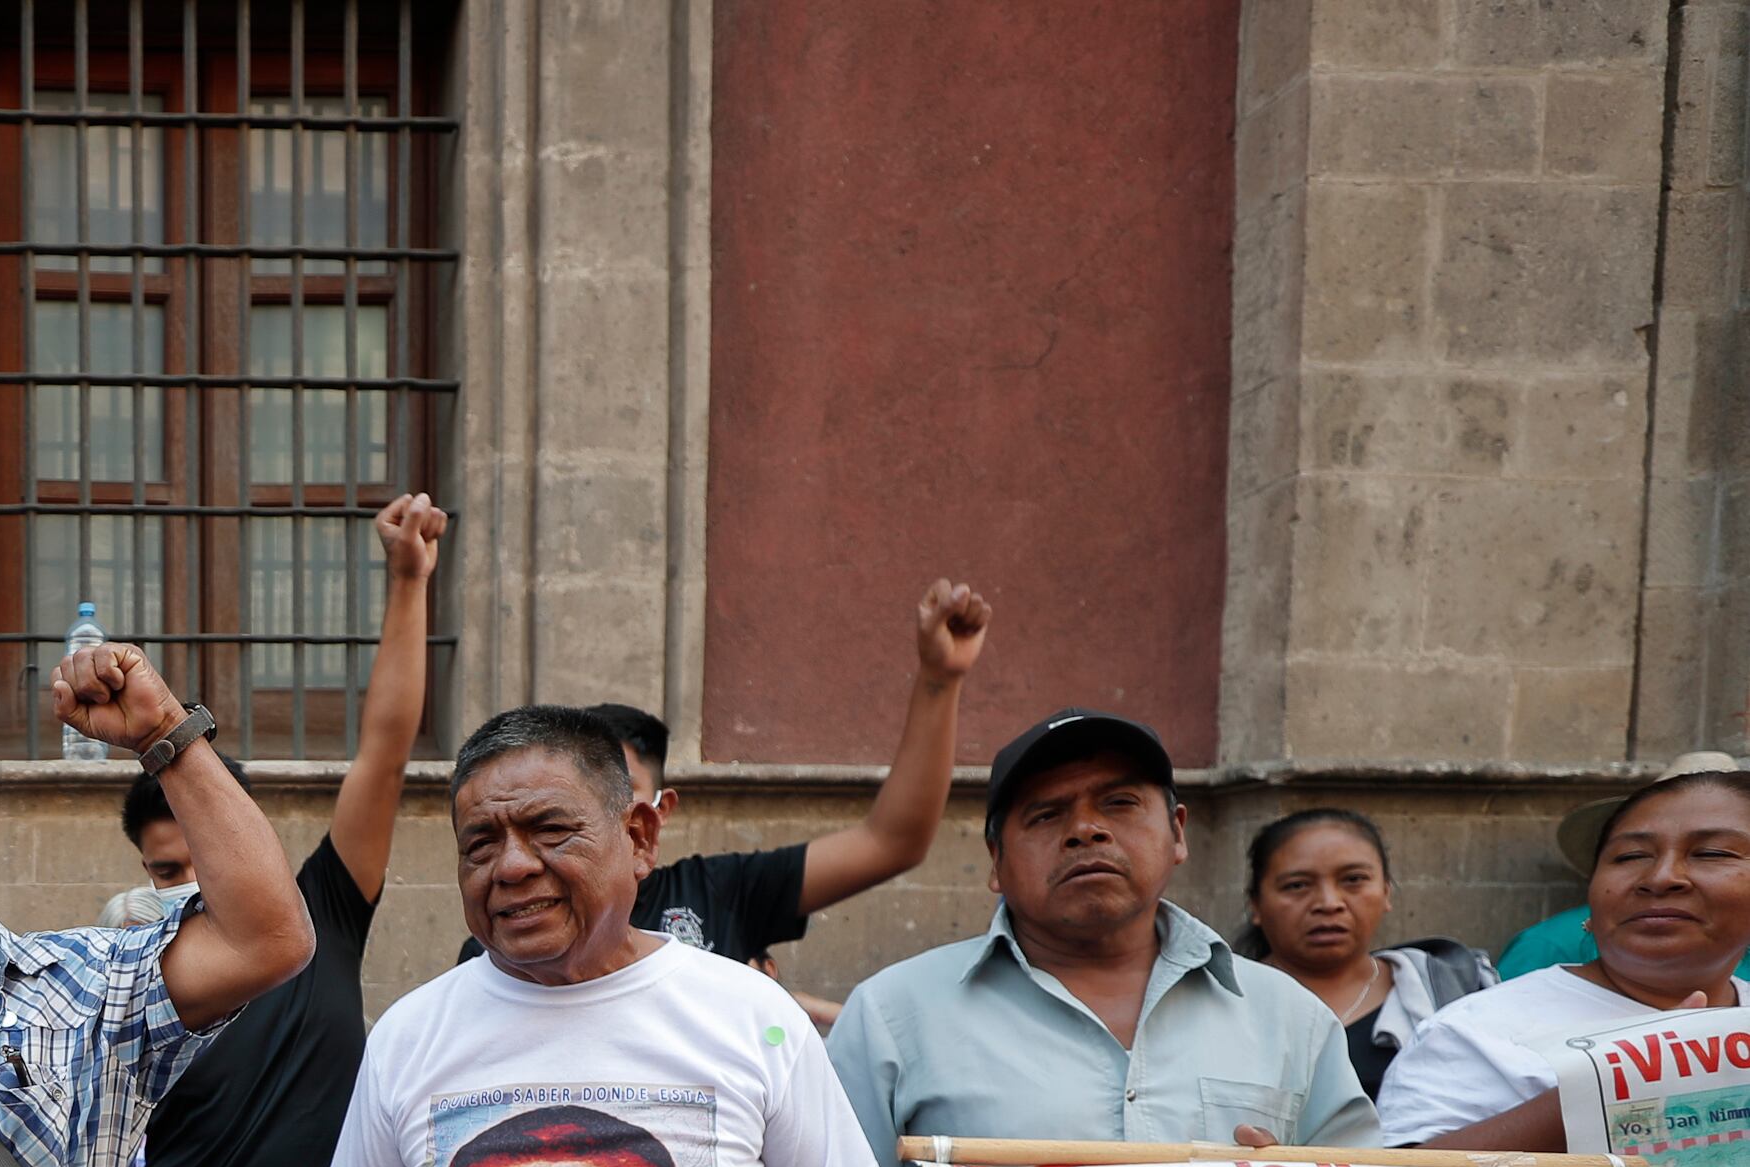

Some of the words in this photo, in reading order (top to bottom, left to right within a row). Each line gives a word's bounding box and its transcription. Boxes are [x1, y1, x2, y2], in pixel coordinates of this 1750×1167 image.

[1605, 1030, 1750, 1101] ¡Vivo
[438, 1088, 502, 1111] QUIERO
[513, 1086, 571, 1102] SABER
[582, 1086, 649, 1102] DONDE
[660, 1088, 708, 1103] ESTA
[1619, 1121, 1652, 1136] Yo,
[1666, 1114, 1699, 1130] Jan
